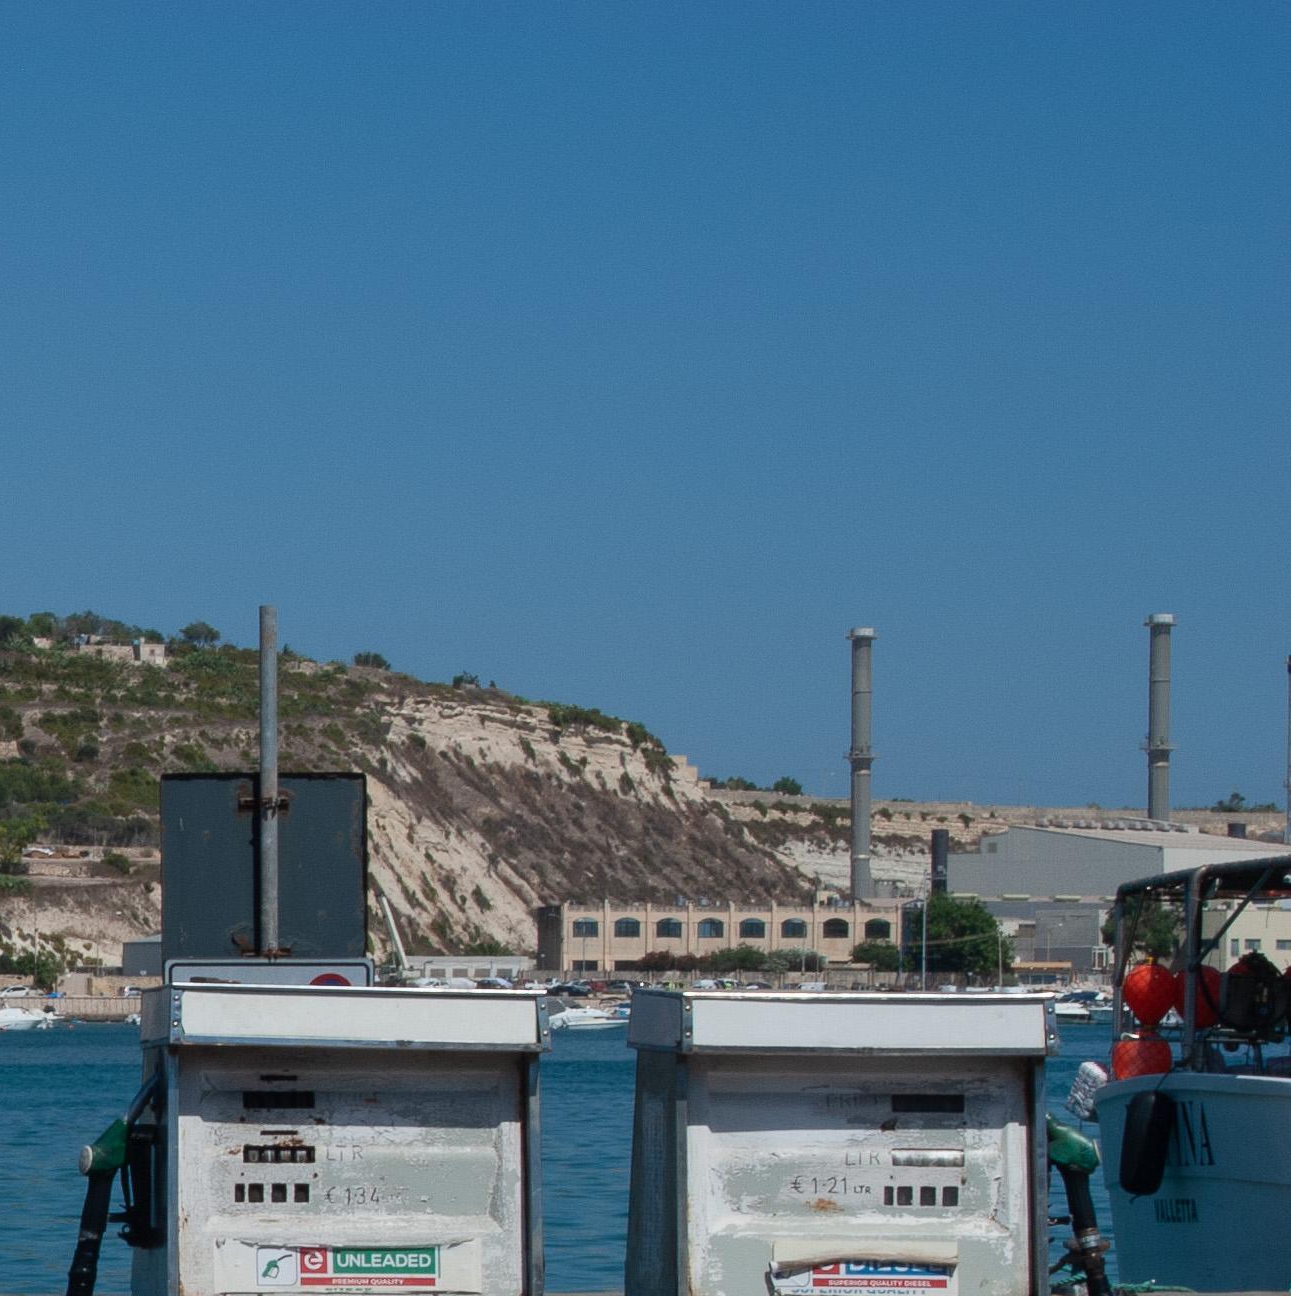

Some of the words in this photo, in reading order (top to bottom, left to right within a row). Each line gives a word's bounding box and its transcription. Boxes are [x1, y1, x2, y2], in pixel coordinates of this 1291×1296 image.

[1154, 1198, 1199, 1224] VALLETTA
[336, 1250, 432, 1269] UNLEADED
[828, 1279, 867, 1287] SUPERIOR
[869, 1279, 903, 1288] QUALITY
[904, 1280, 931, 1288] DIESEL
